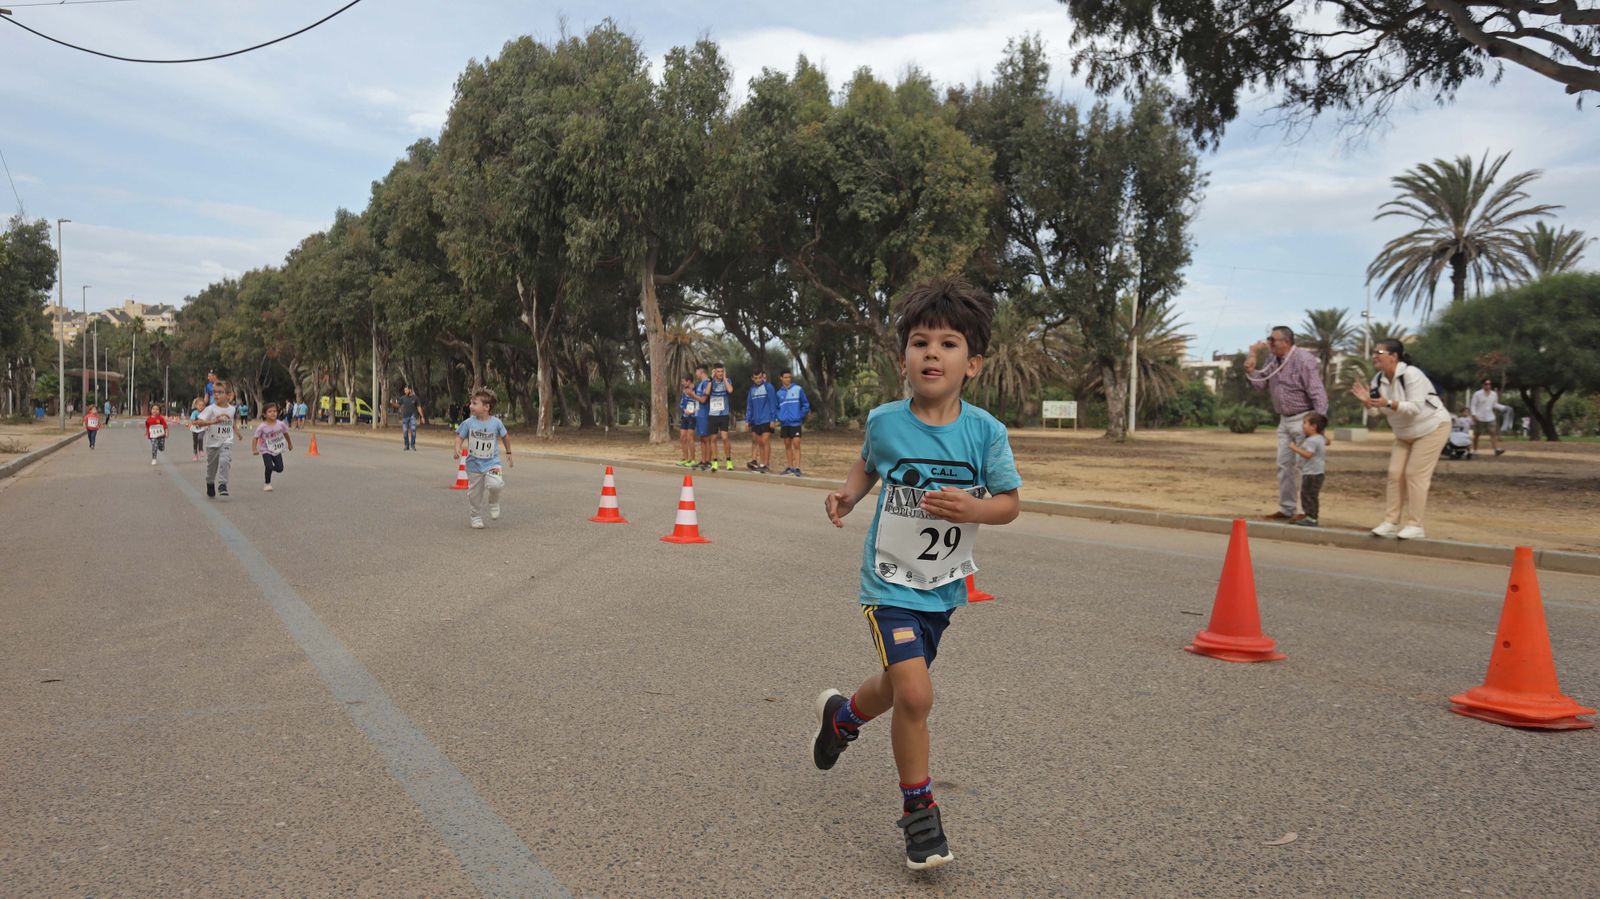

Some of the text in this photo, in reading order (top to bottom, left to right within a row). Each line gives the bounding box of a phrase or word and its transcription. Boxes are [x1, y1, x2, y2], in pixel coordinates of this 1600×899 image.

[475, 441, 492, 451] 119
[931, 467, 958, 477] C.A.L.
[916, 526, 962, 561] 29
